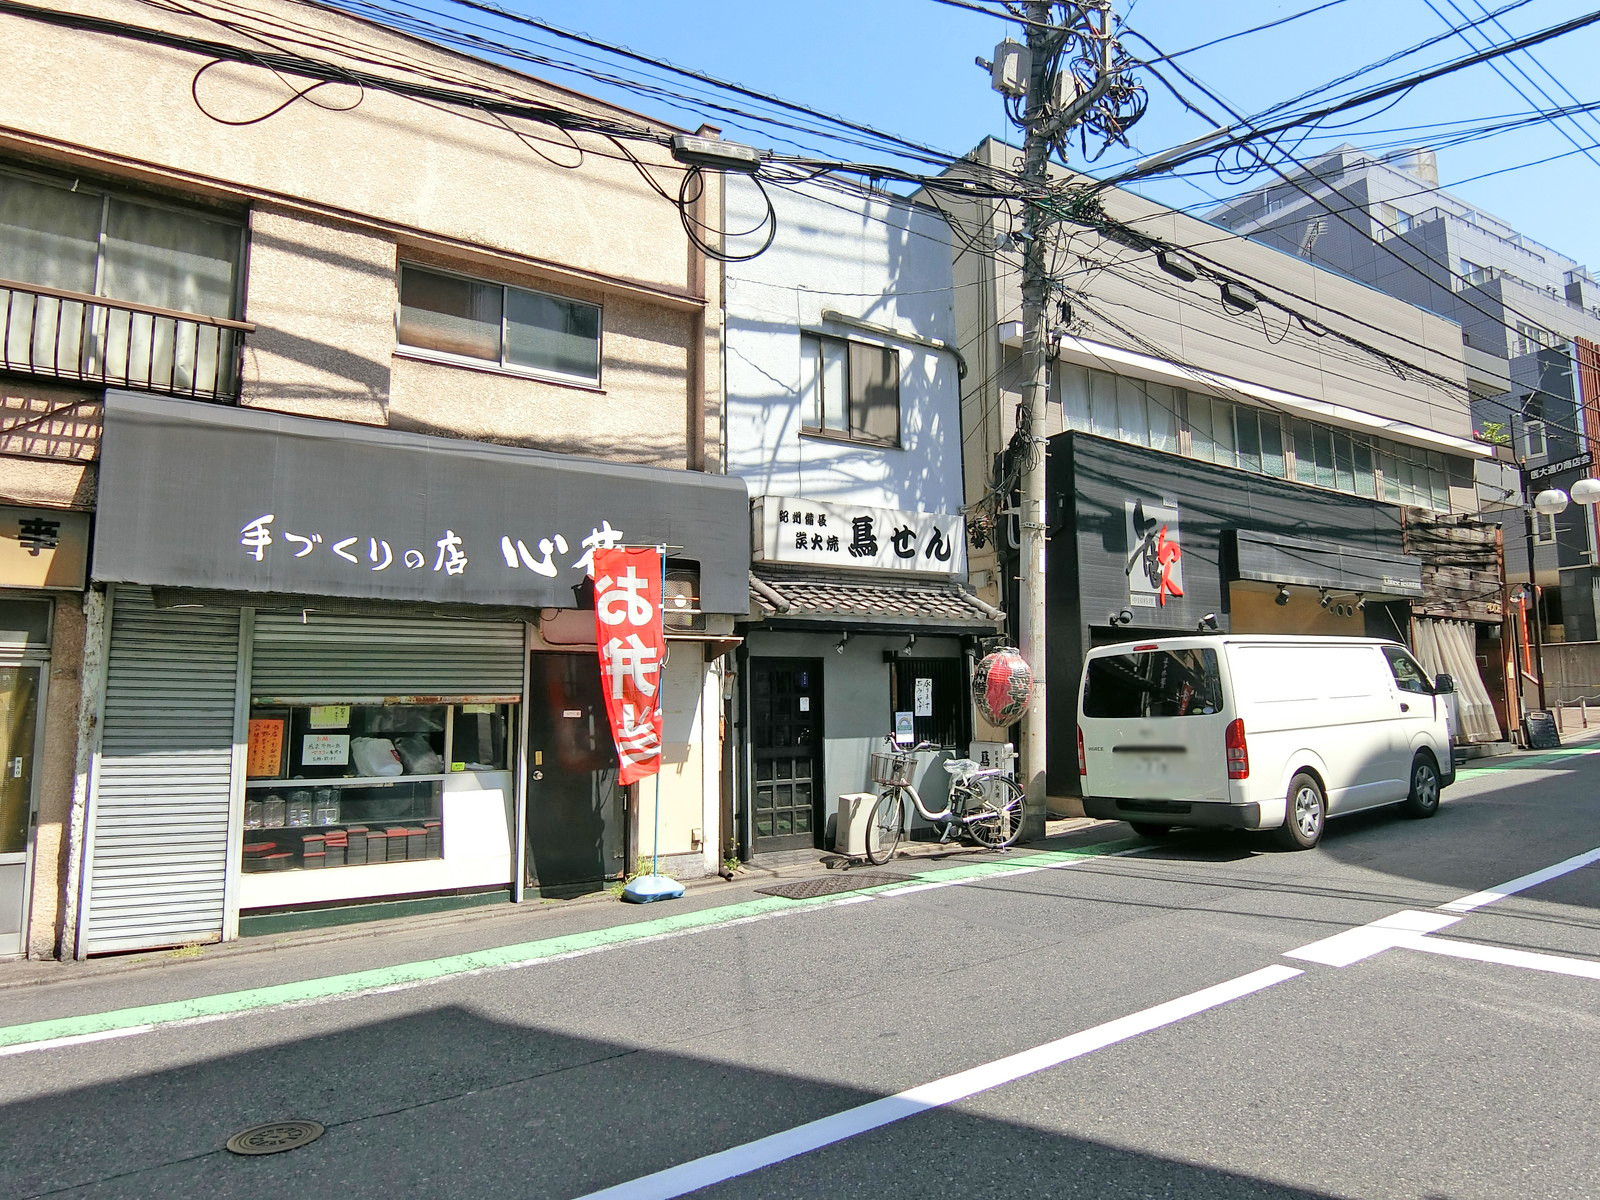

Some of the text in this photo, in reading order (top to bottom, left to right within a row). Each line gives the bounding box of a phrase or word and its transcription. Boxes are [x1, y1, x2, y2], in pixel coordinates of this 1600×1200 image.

[1530, 454, 1591, 480] 医大通り商店会
[241, 513, 468, 576] 手づくりの店
[795, 531, 839, 553] 炭火焼
